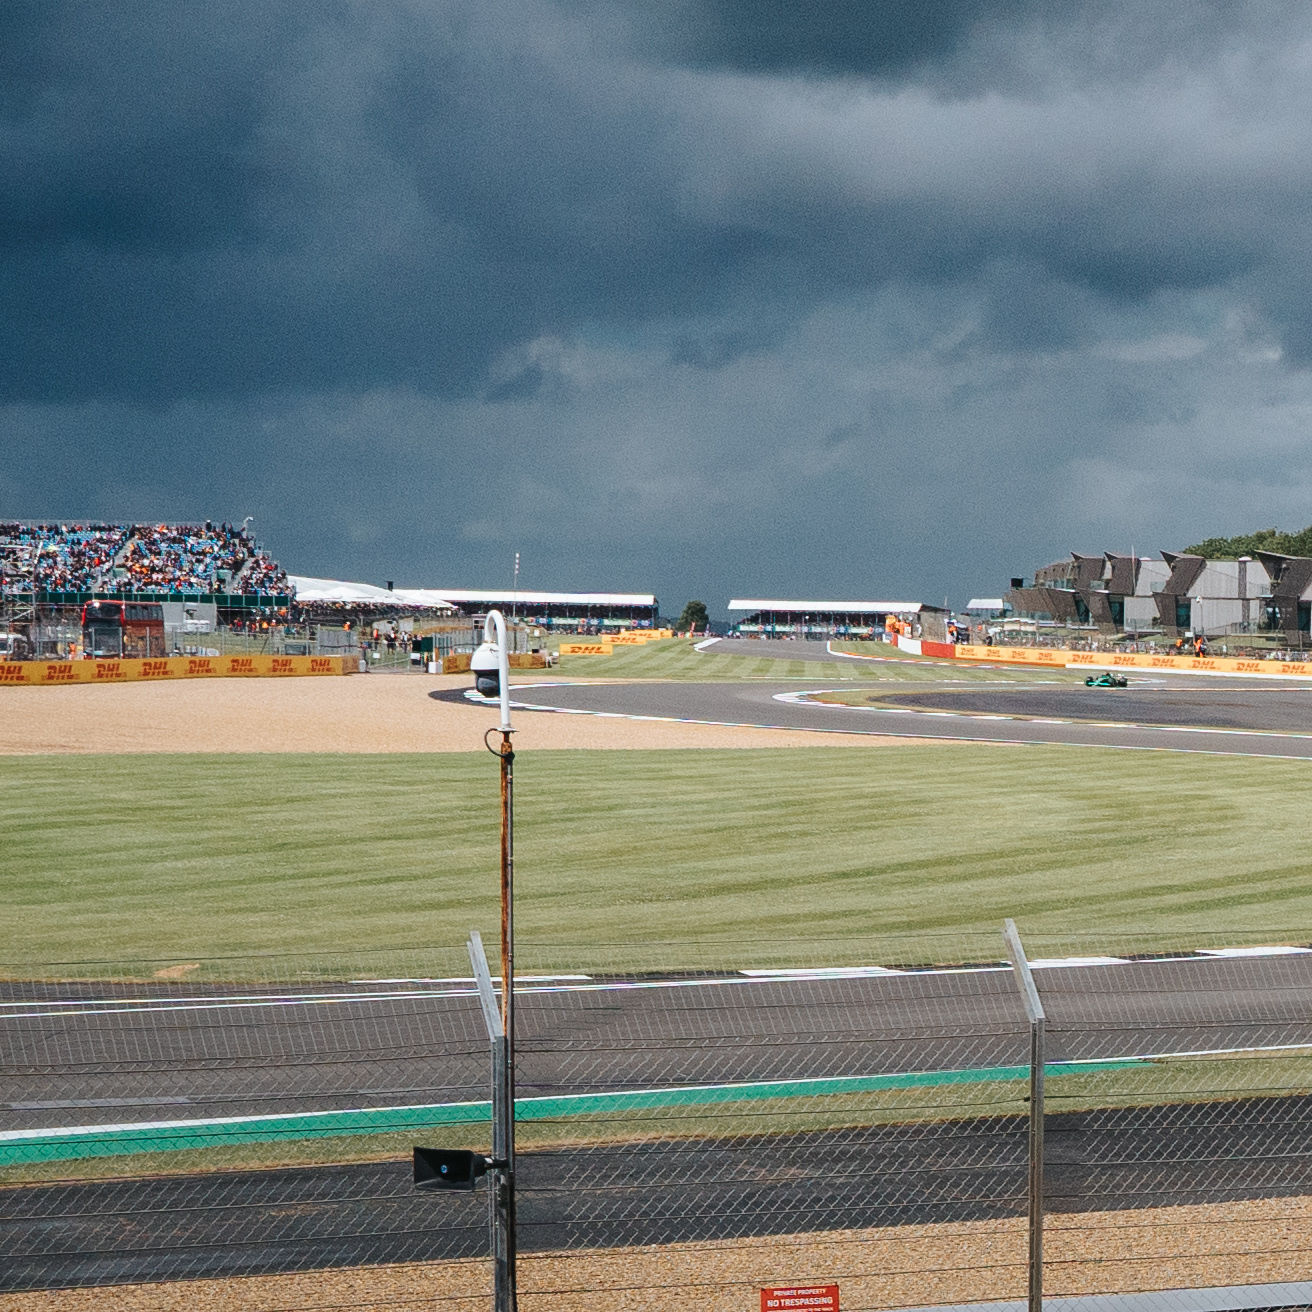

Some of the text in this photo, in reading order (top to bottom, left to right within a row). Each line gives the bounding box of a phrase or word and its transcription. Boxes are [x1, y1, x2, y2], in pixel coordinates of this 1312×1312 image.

[570, 646, 604, 654] DHL
[1072, 653, 1095, 663] DHL
[1113, 656, 1136, 665] DHL
[1152, 658, 1176, 667] DHL
[1192, 660, 1216, 669] DHL
[1236, 662, 1261, 671] DHL
[1281, 664, 1306, 674] DHL
[767, 1296, 833, 1307] NO TRESPASSING
